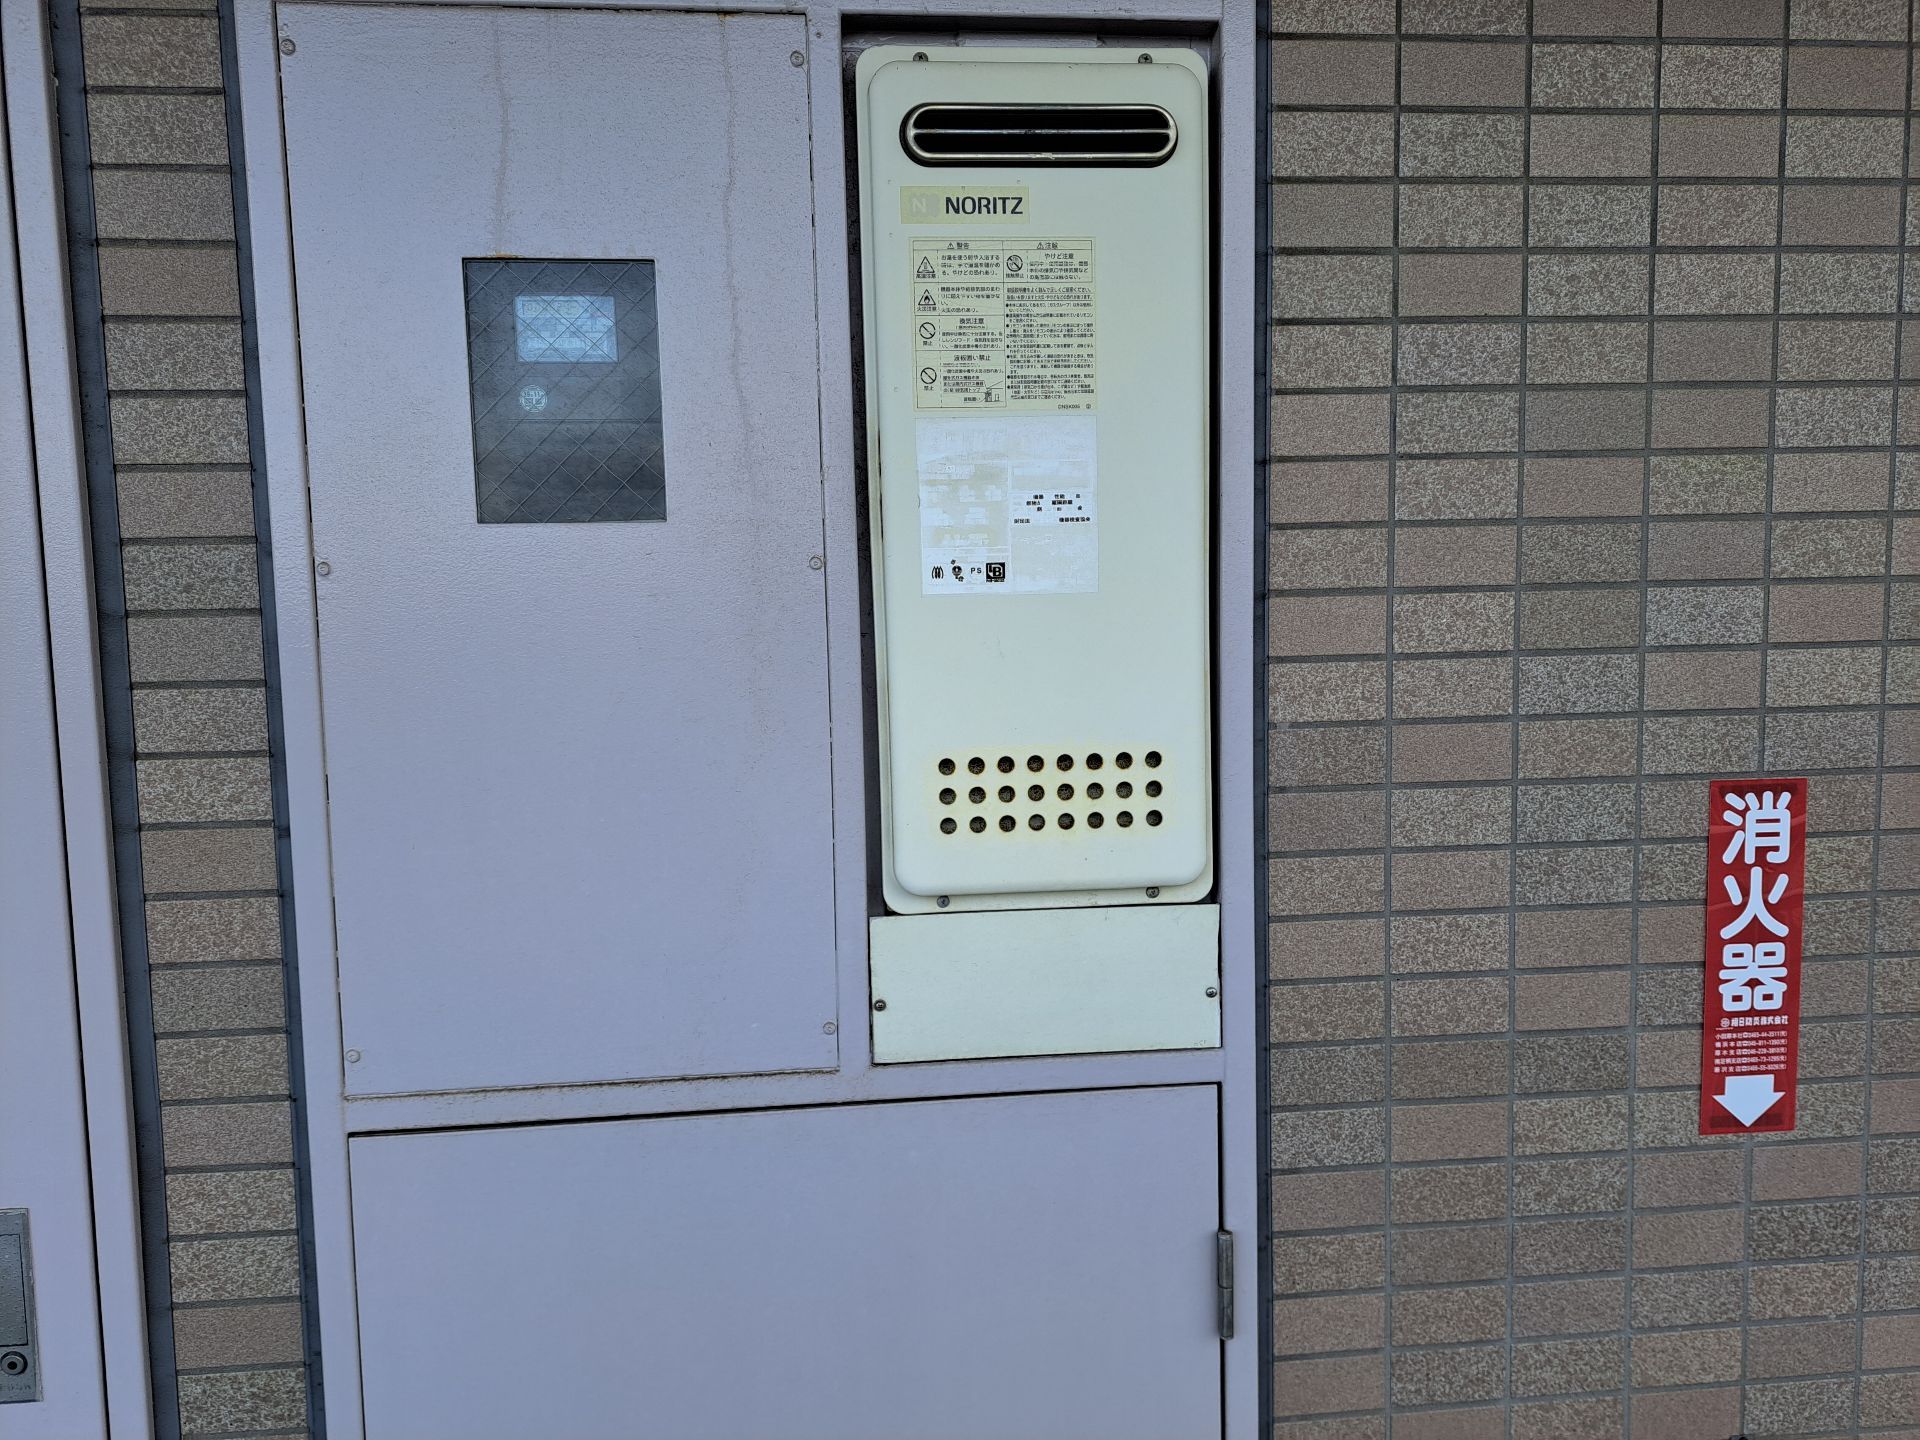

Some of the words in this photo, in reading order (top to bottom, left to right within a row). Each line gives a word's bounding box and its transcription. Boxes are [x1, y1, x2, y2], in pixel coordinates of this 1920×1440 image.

[945, 196, 1024, 215] NORITZ
[1718, 790, 1792, 1012] 消火器
